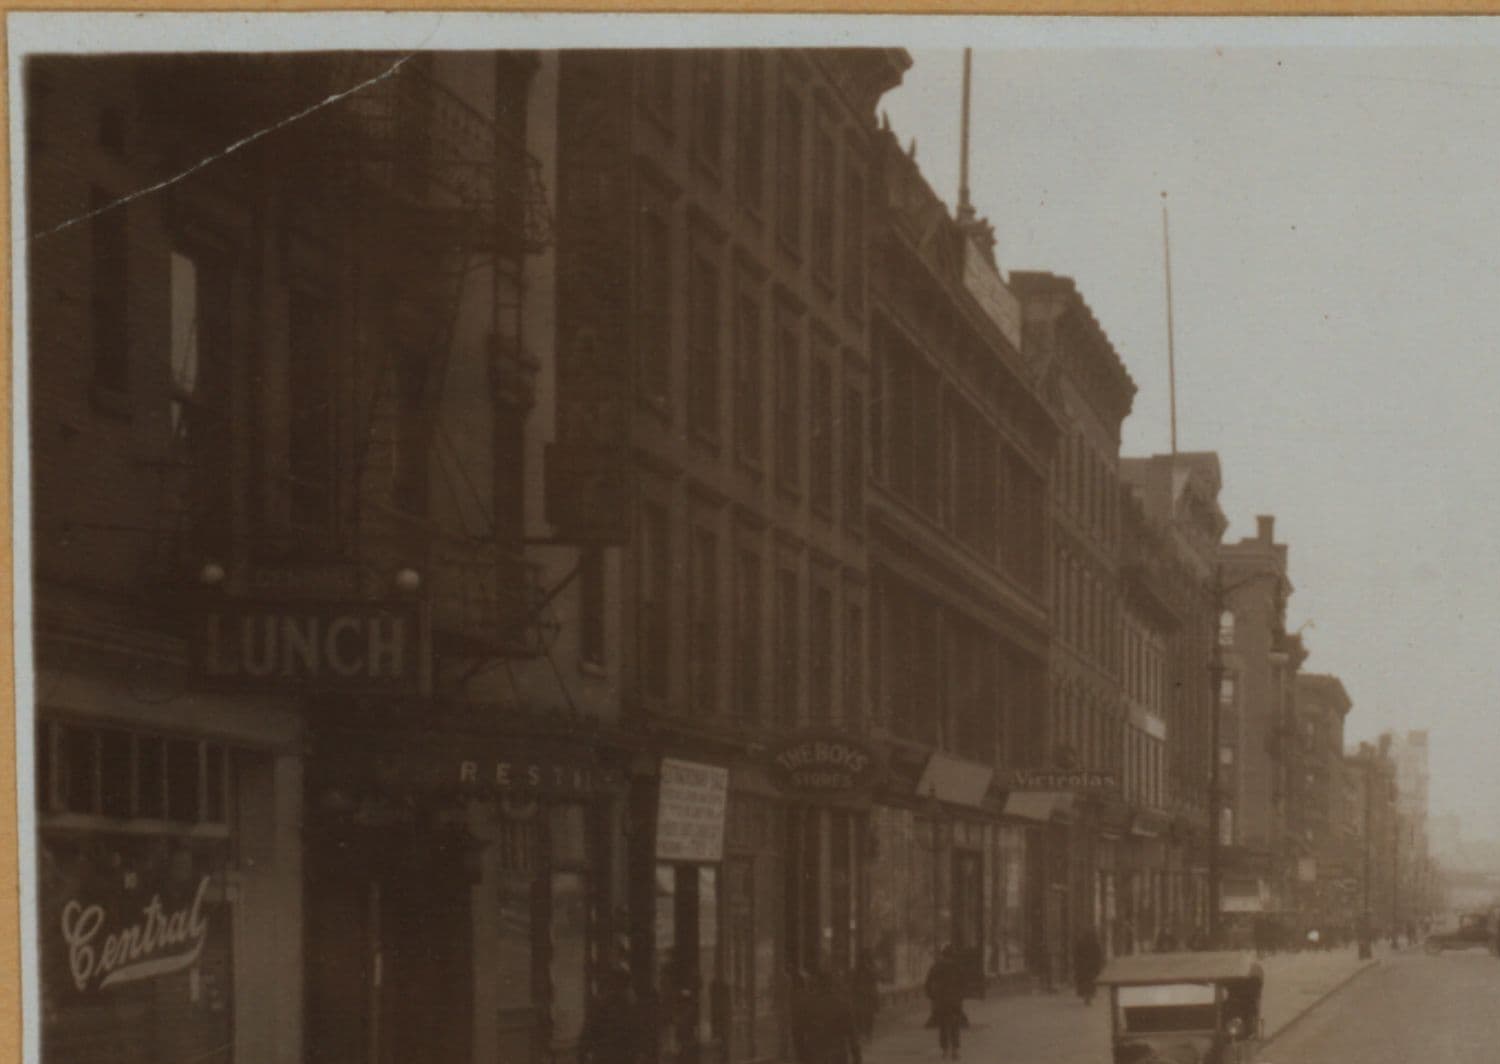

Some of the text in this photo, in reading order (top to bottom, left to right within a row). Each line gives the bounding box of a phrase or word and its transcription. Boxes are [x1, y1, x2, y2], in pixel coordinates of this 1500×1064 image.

[206, 613, 404, 676] LUNCH
[815, 741, 869, 772] BOYS
[61, 875, 210, 992] Central
